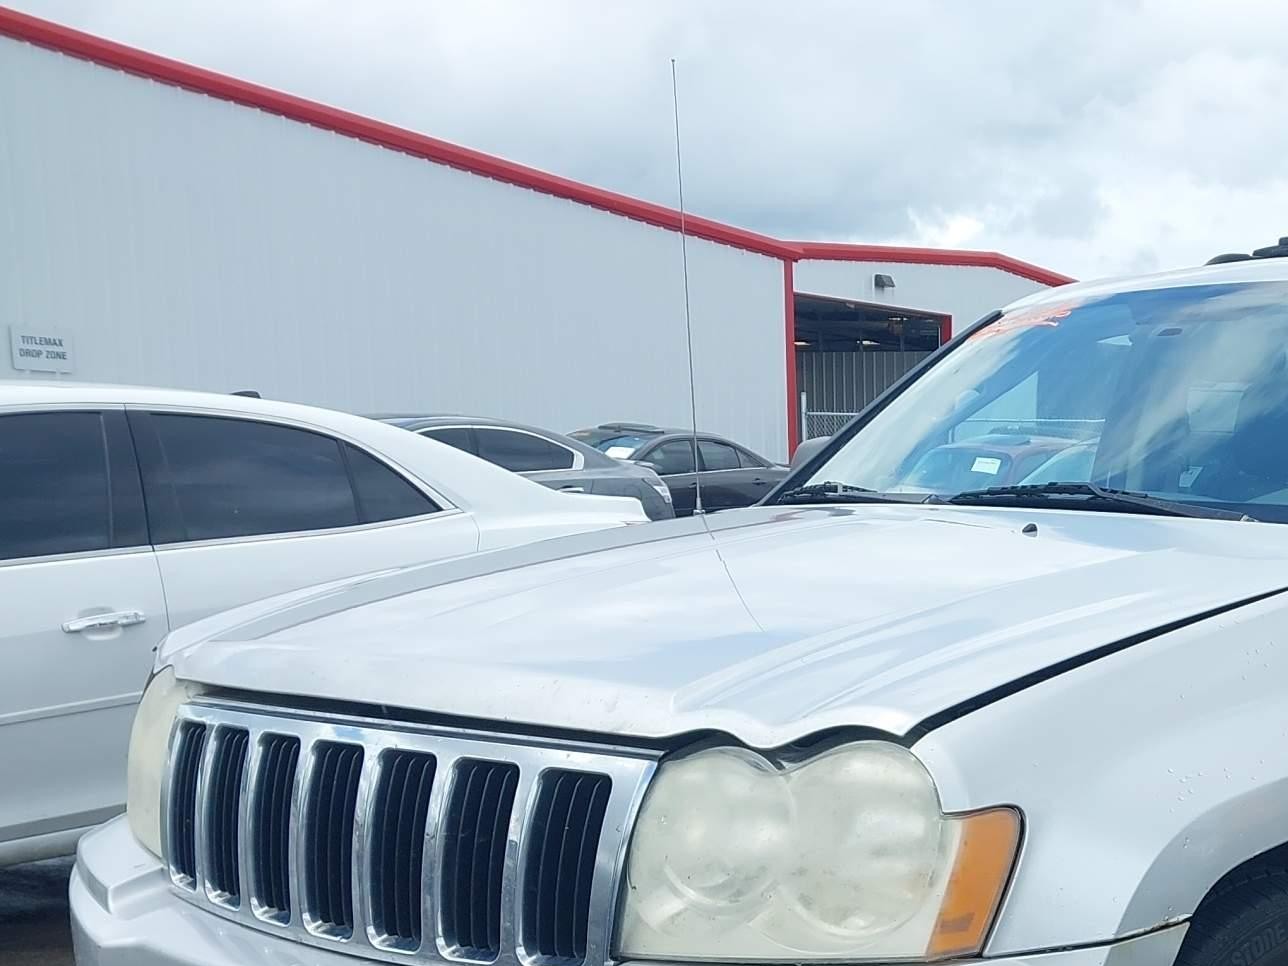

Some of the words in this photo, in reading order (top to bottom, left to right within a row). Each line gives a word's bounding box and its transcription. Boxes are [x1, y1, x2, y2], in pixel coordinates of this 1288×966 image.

[20, 335, 64, 347] TITLEMAX
[19, 348, 43, 358] DROP
[45, 350, 67, 360] ZONE
